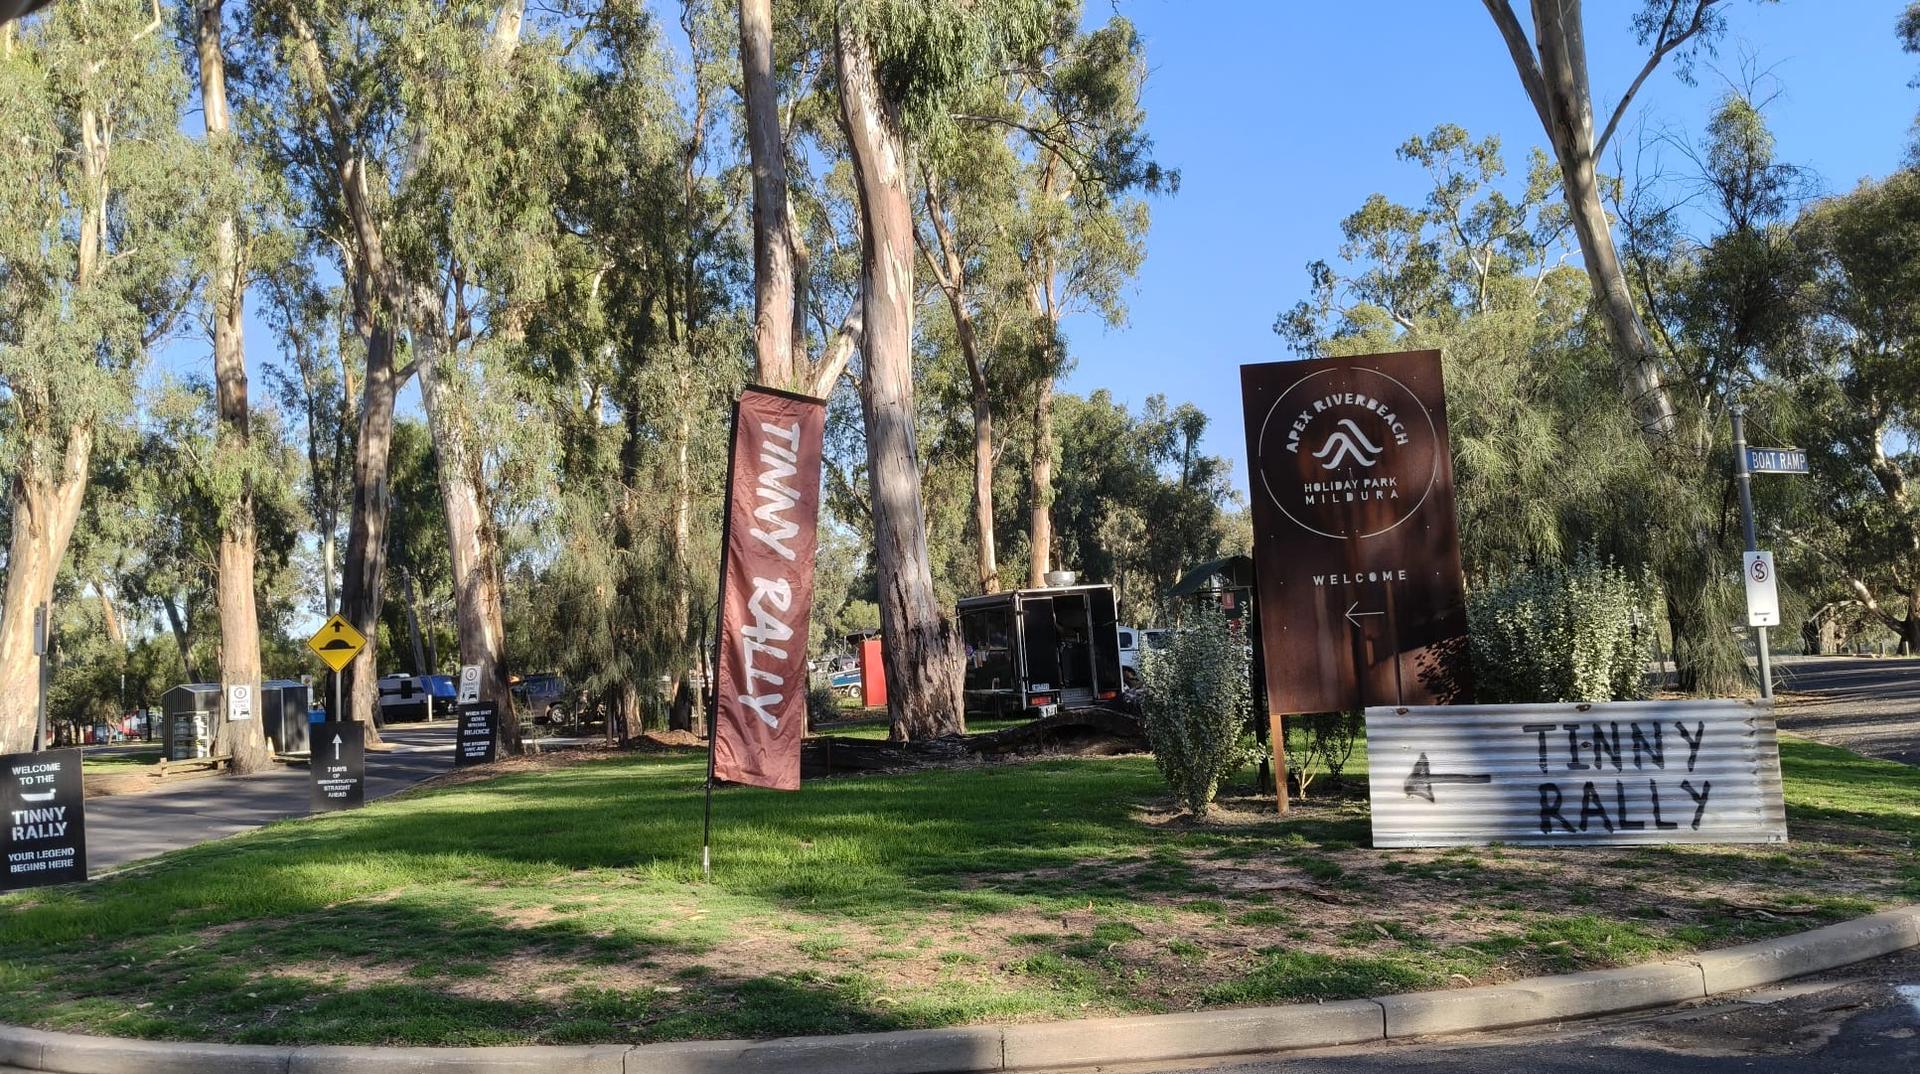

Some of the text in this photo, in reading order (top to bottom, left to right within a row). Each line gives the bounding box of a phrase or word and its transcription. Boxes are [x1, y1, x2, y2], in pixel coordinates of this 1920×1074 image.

[1286, 392, 1409, 453] APEX RIVERBEACH
[1752, 452, 1806, 470] BOAT RAMP
[1304, 477, 1398, 493] HOLIDAY PARK
[1305, 491, 1399, 505] MILDURA
[738, 422, 801, 729] TINNY RALLY
[1313, 570, 1407, 586] WELCOME
[1522, 720, 1705, 774] TINNY
[12, 762, 61, 776] WELCOME
[20, 774, 55, 786] TO THE
[11, 806, 66, 825] TINNY
[1538, 779, 1711, 835] RALLY
[12, 822, 68, 841] RALLY
[8, 847, 75, 862] YOUR LEGEND
[10, 859, 74, 873] BEGINS HERE
